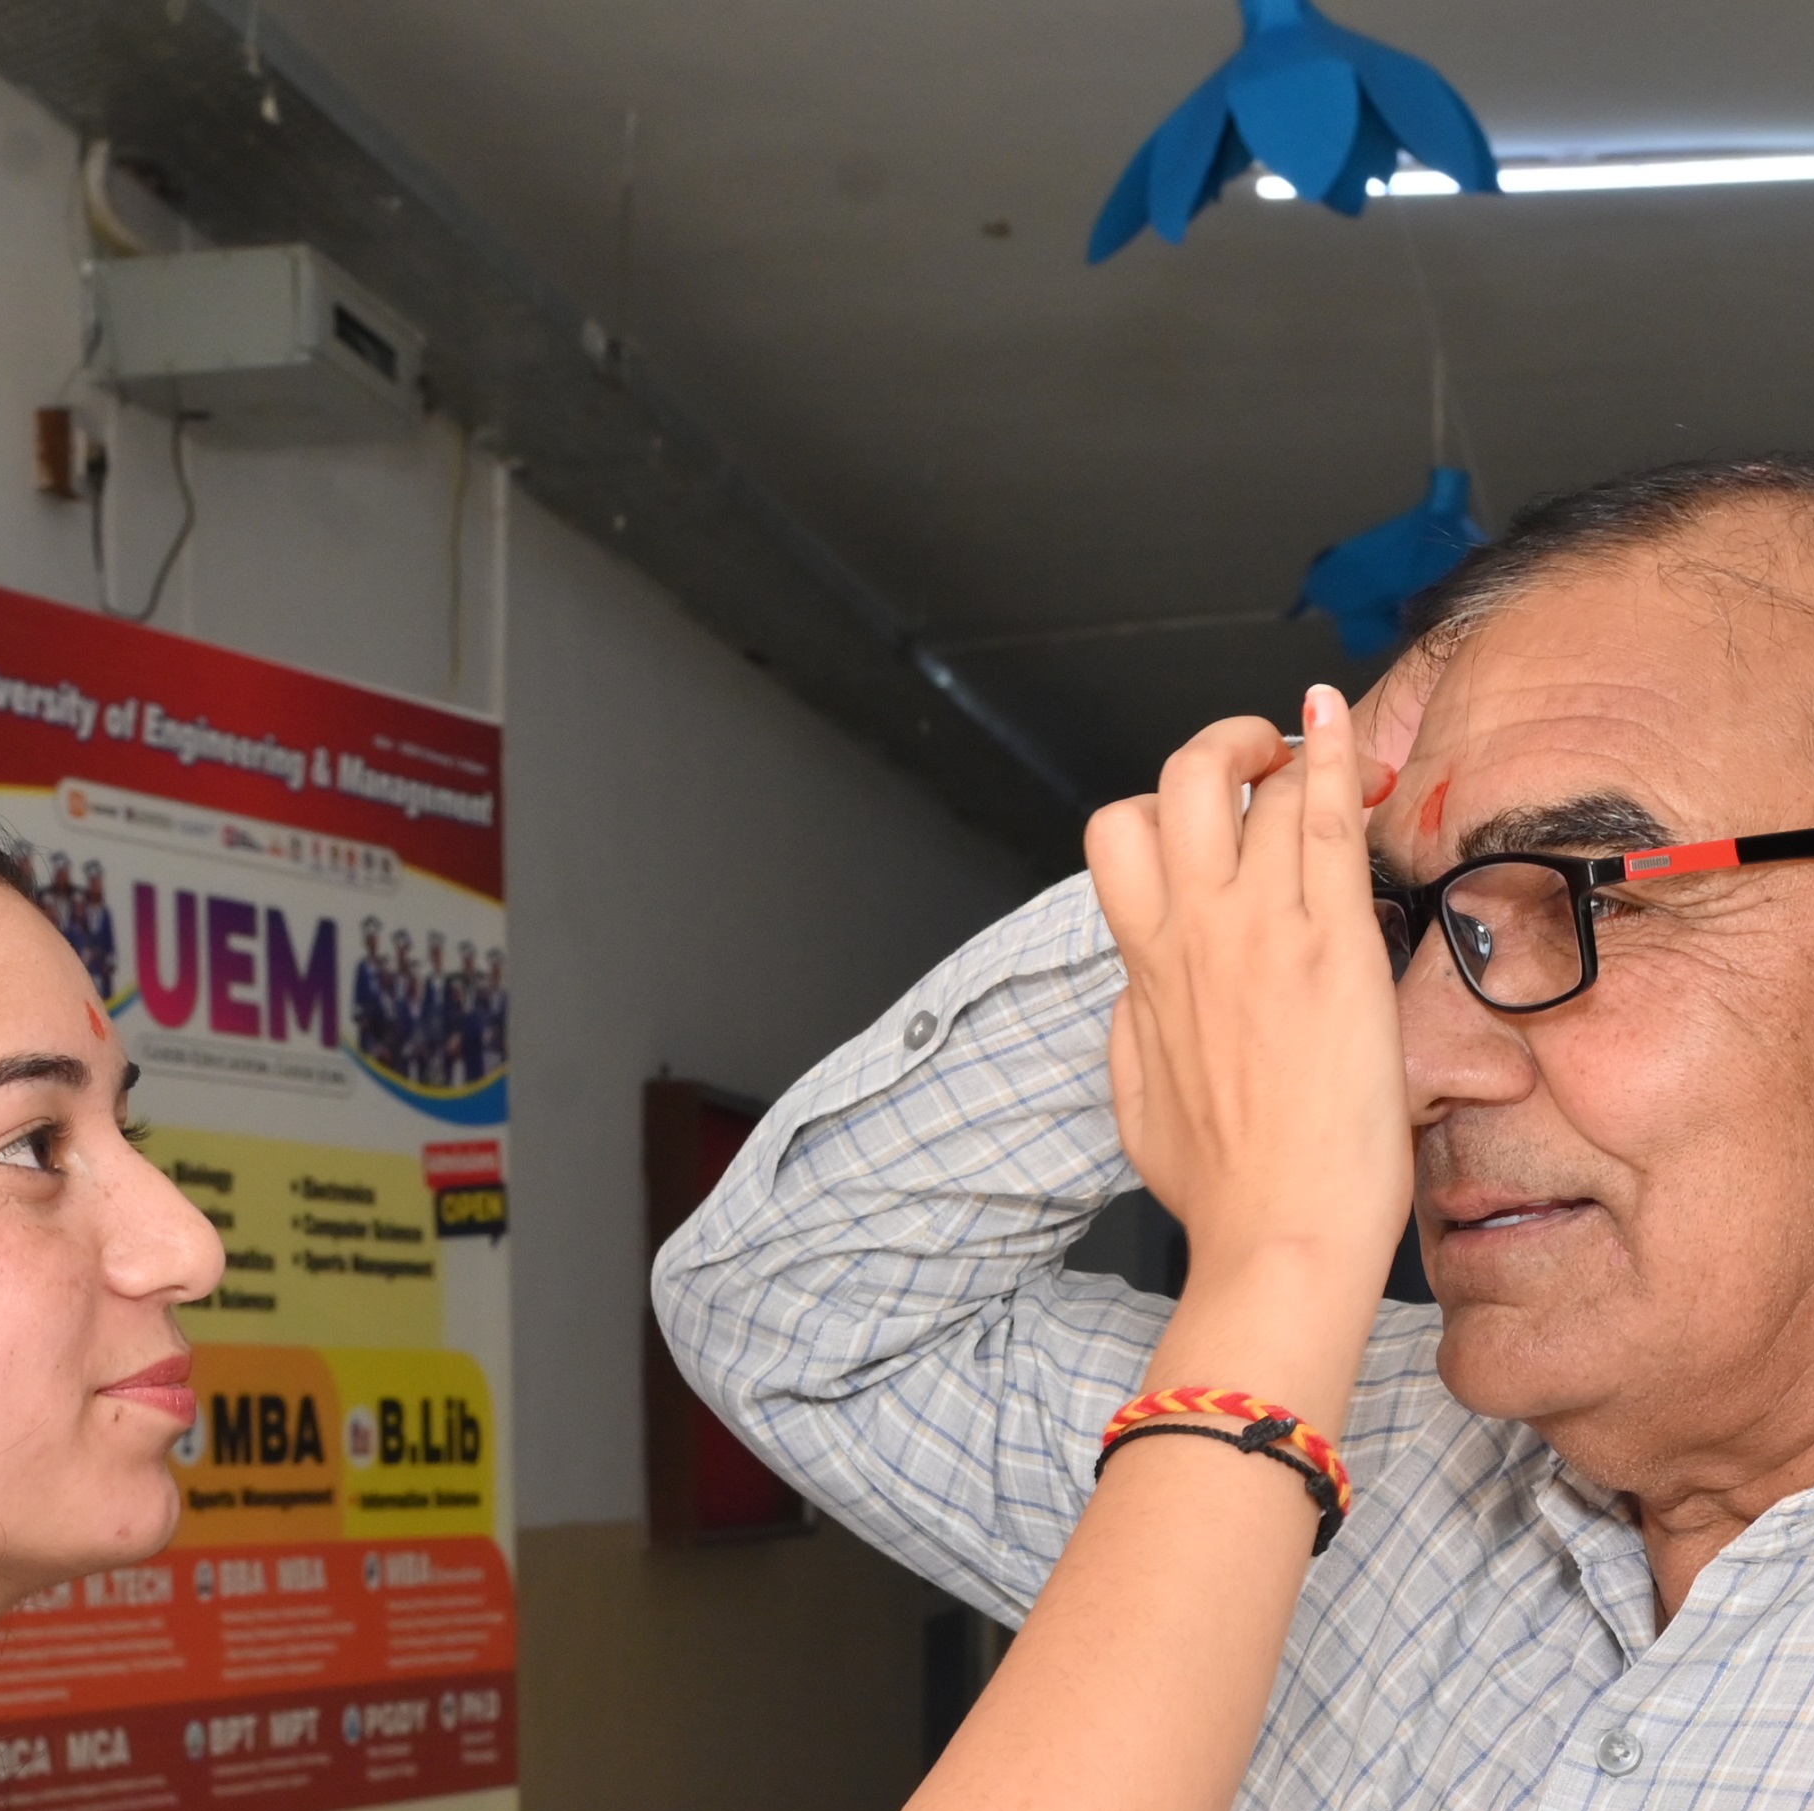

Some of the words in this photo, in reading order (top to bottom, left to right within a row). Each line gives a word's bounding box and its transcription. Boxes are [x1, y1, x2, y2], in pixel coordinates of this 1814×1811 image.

[104, 699, 137, 741] of
[142, 704, 306, 794] Engineering
[312, 747, 331, 788] &
[337, 752, 495, 828] Management
[132, 881, 340, 1051] UEM
[442, 1191, 504, 1224] OPEN
[212, 1394, 325, 1466] MBA
[379, 1396, 481, 1465] B.Lib
[85, 1567, 173, 1609] M.TECH
[66, 1726, 131, 1774] MCA
[208, 1711, 260, 1756] BPT
[269, 1707, 321, 1750] MPT
